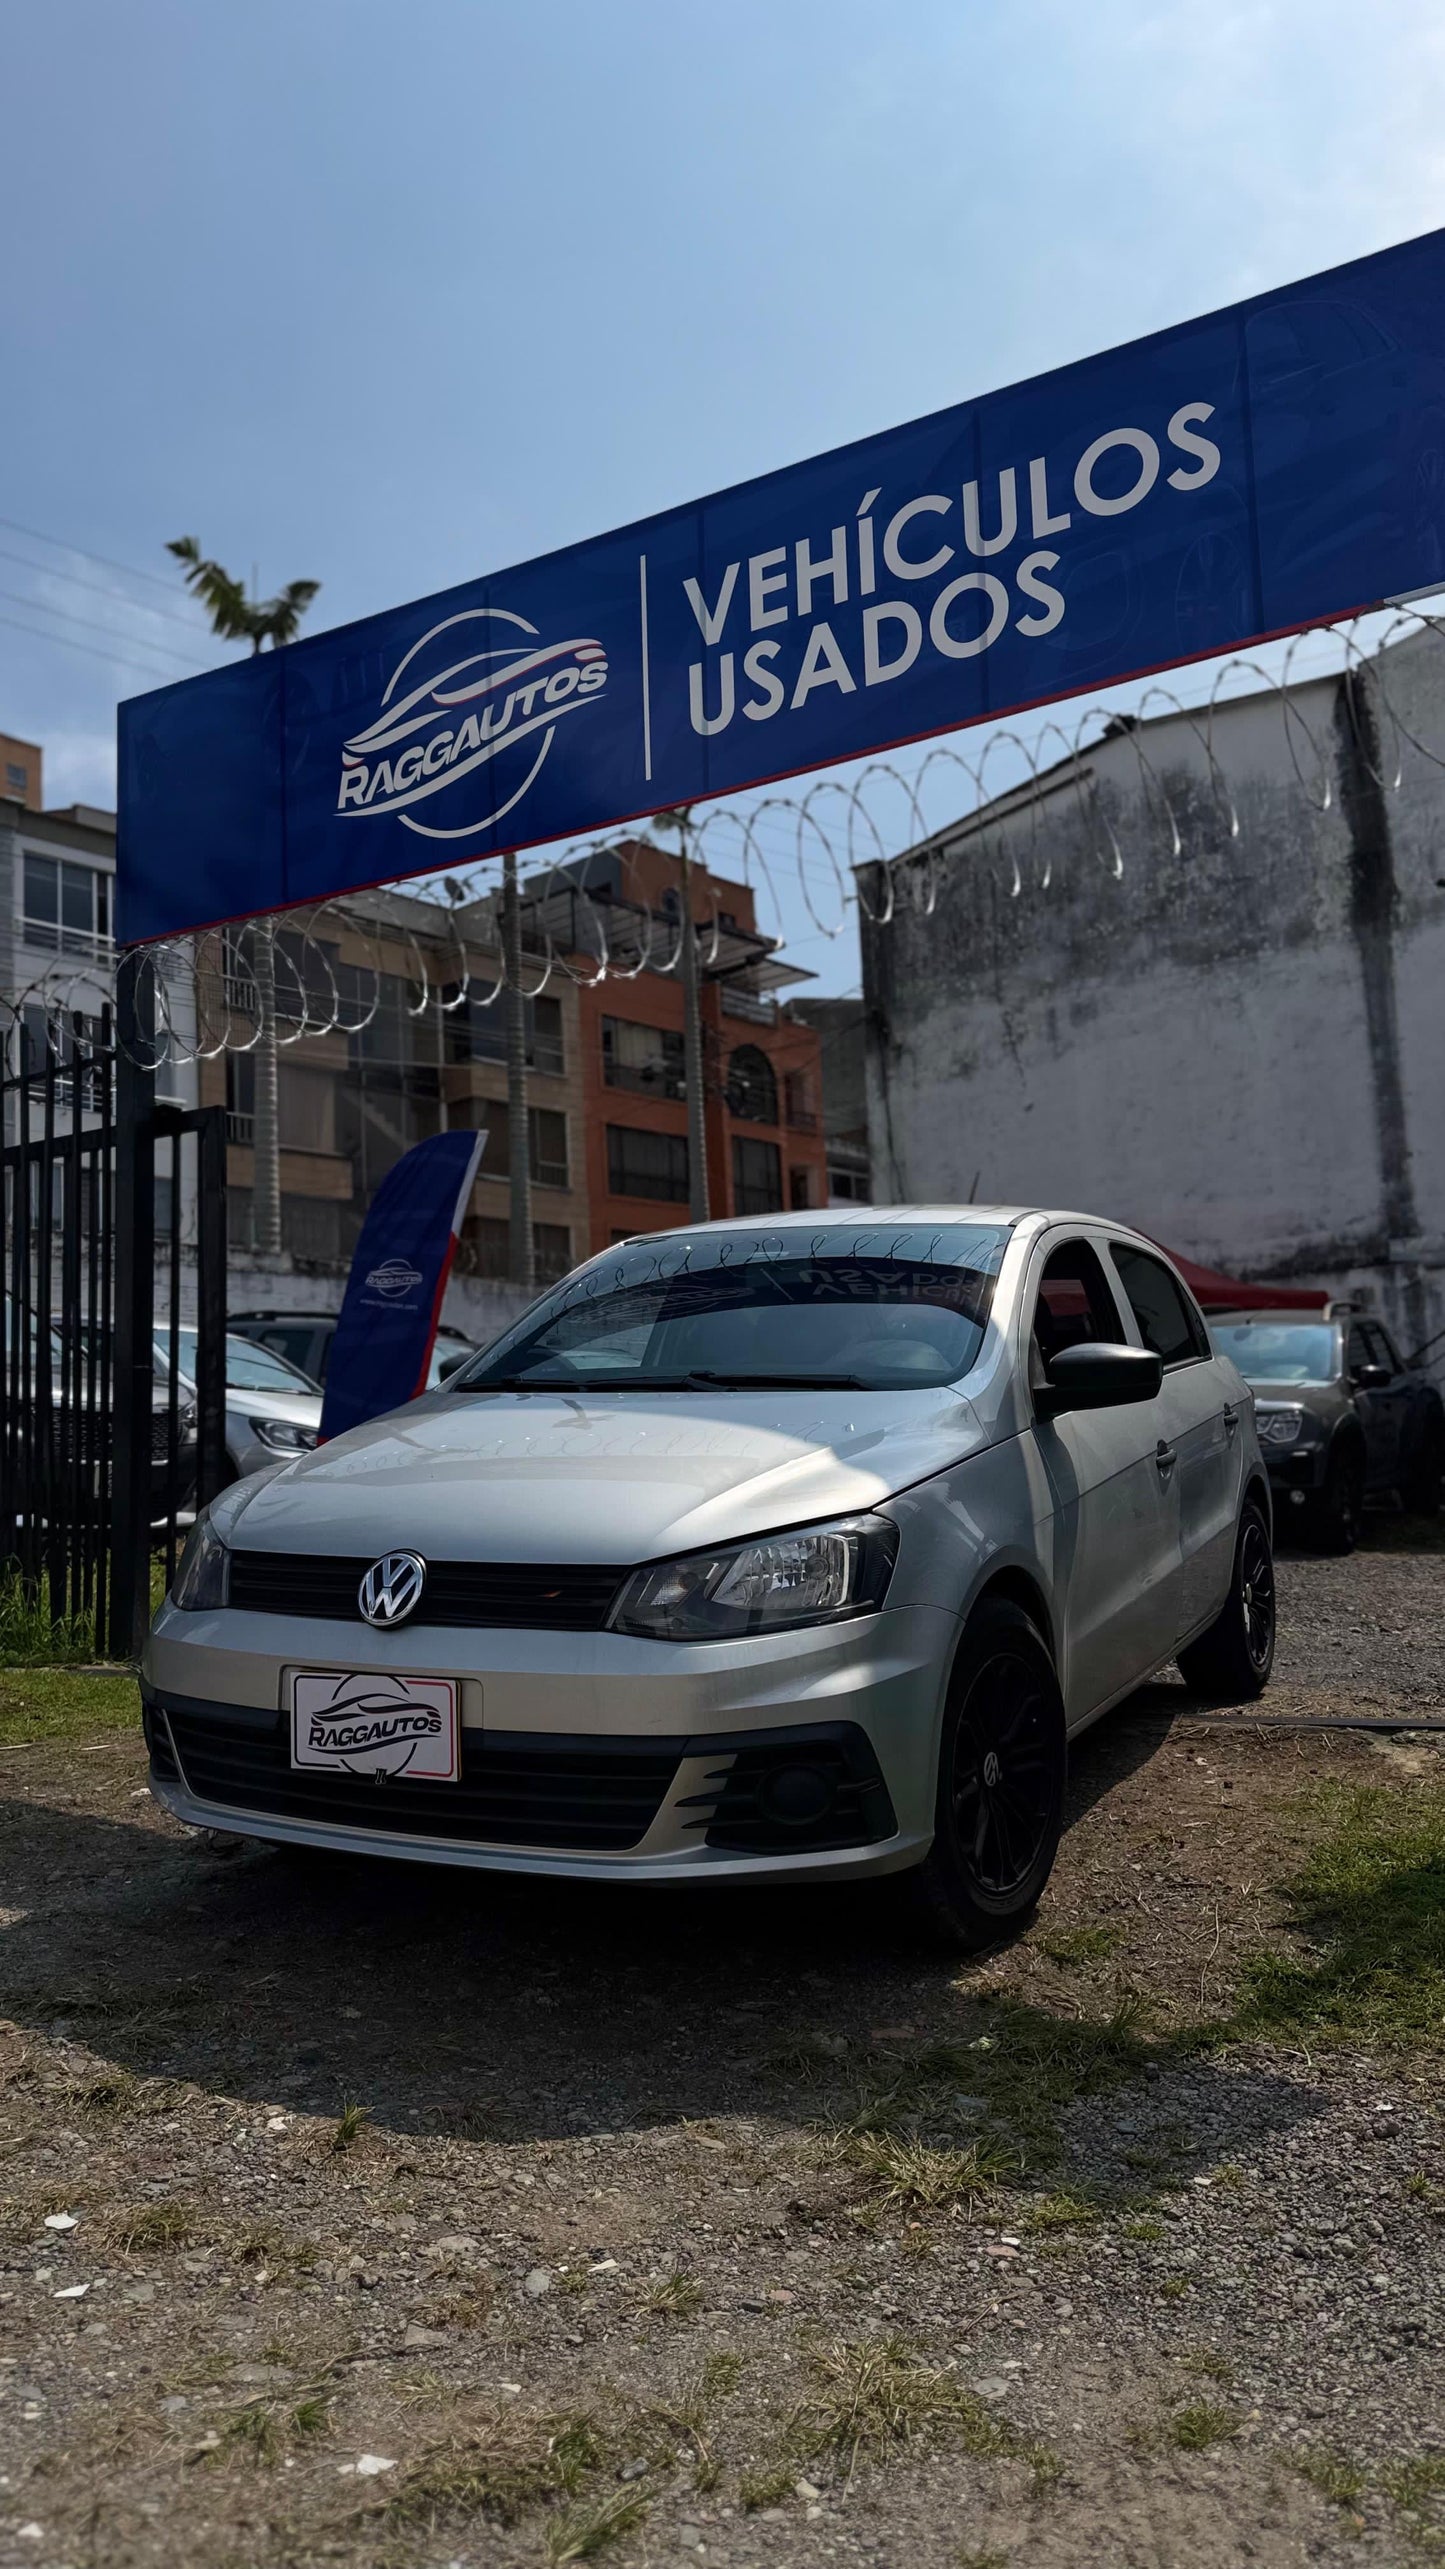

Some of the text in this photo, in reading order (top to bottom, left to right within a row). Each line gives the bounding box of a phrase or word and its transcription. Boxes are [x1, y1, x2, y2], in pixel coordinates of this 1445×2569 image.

[683, 402, 1220, 646] VEHÍCULOS
[689, 551, 1065, 735] USADOS
[337, 661, 608, 809] RAGGAUTOS
[308, 1716, 443, 1747] RAGGAUTOS
